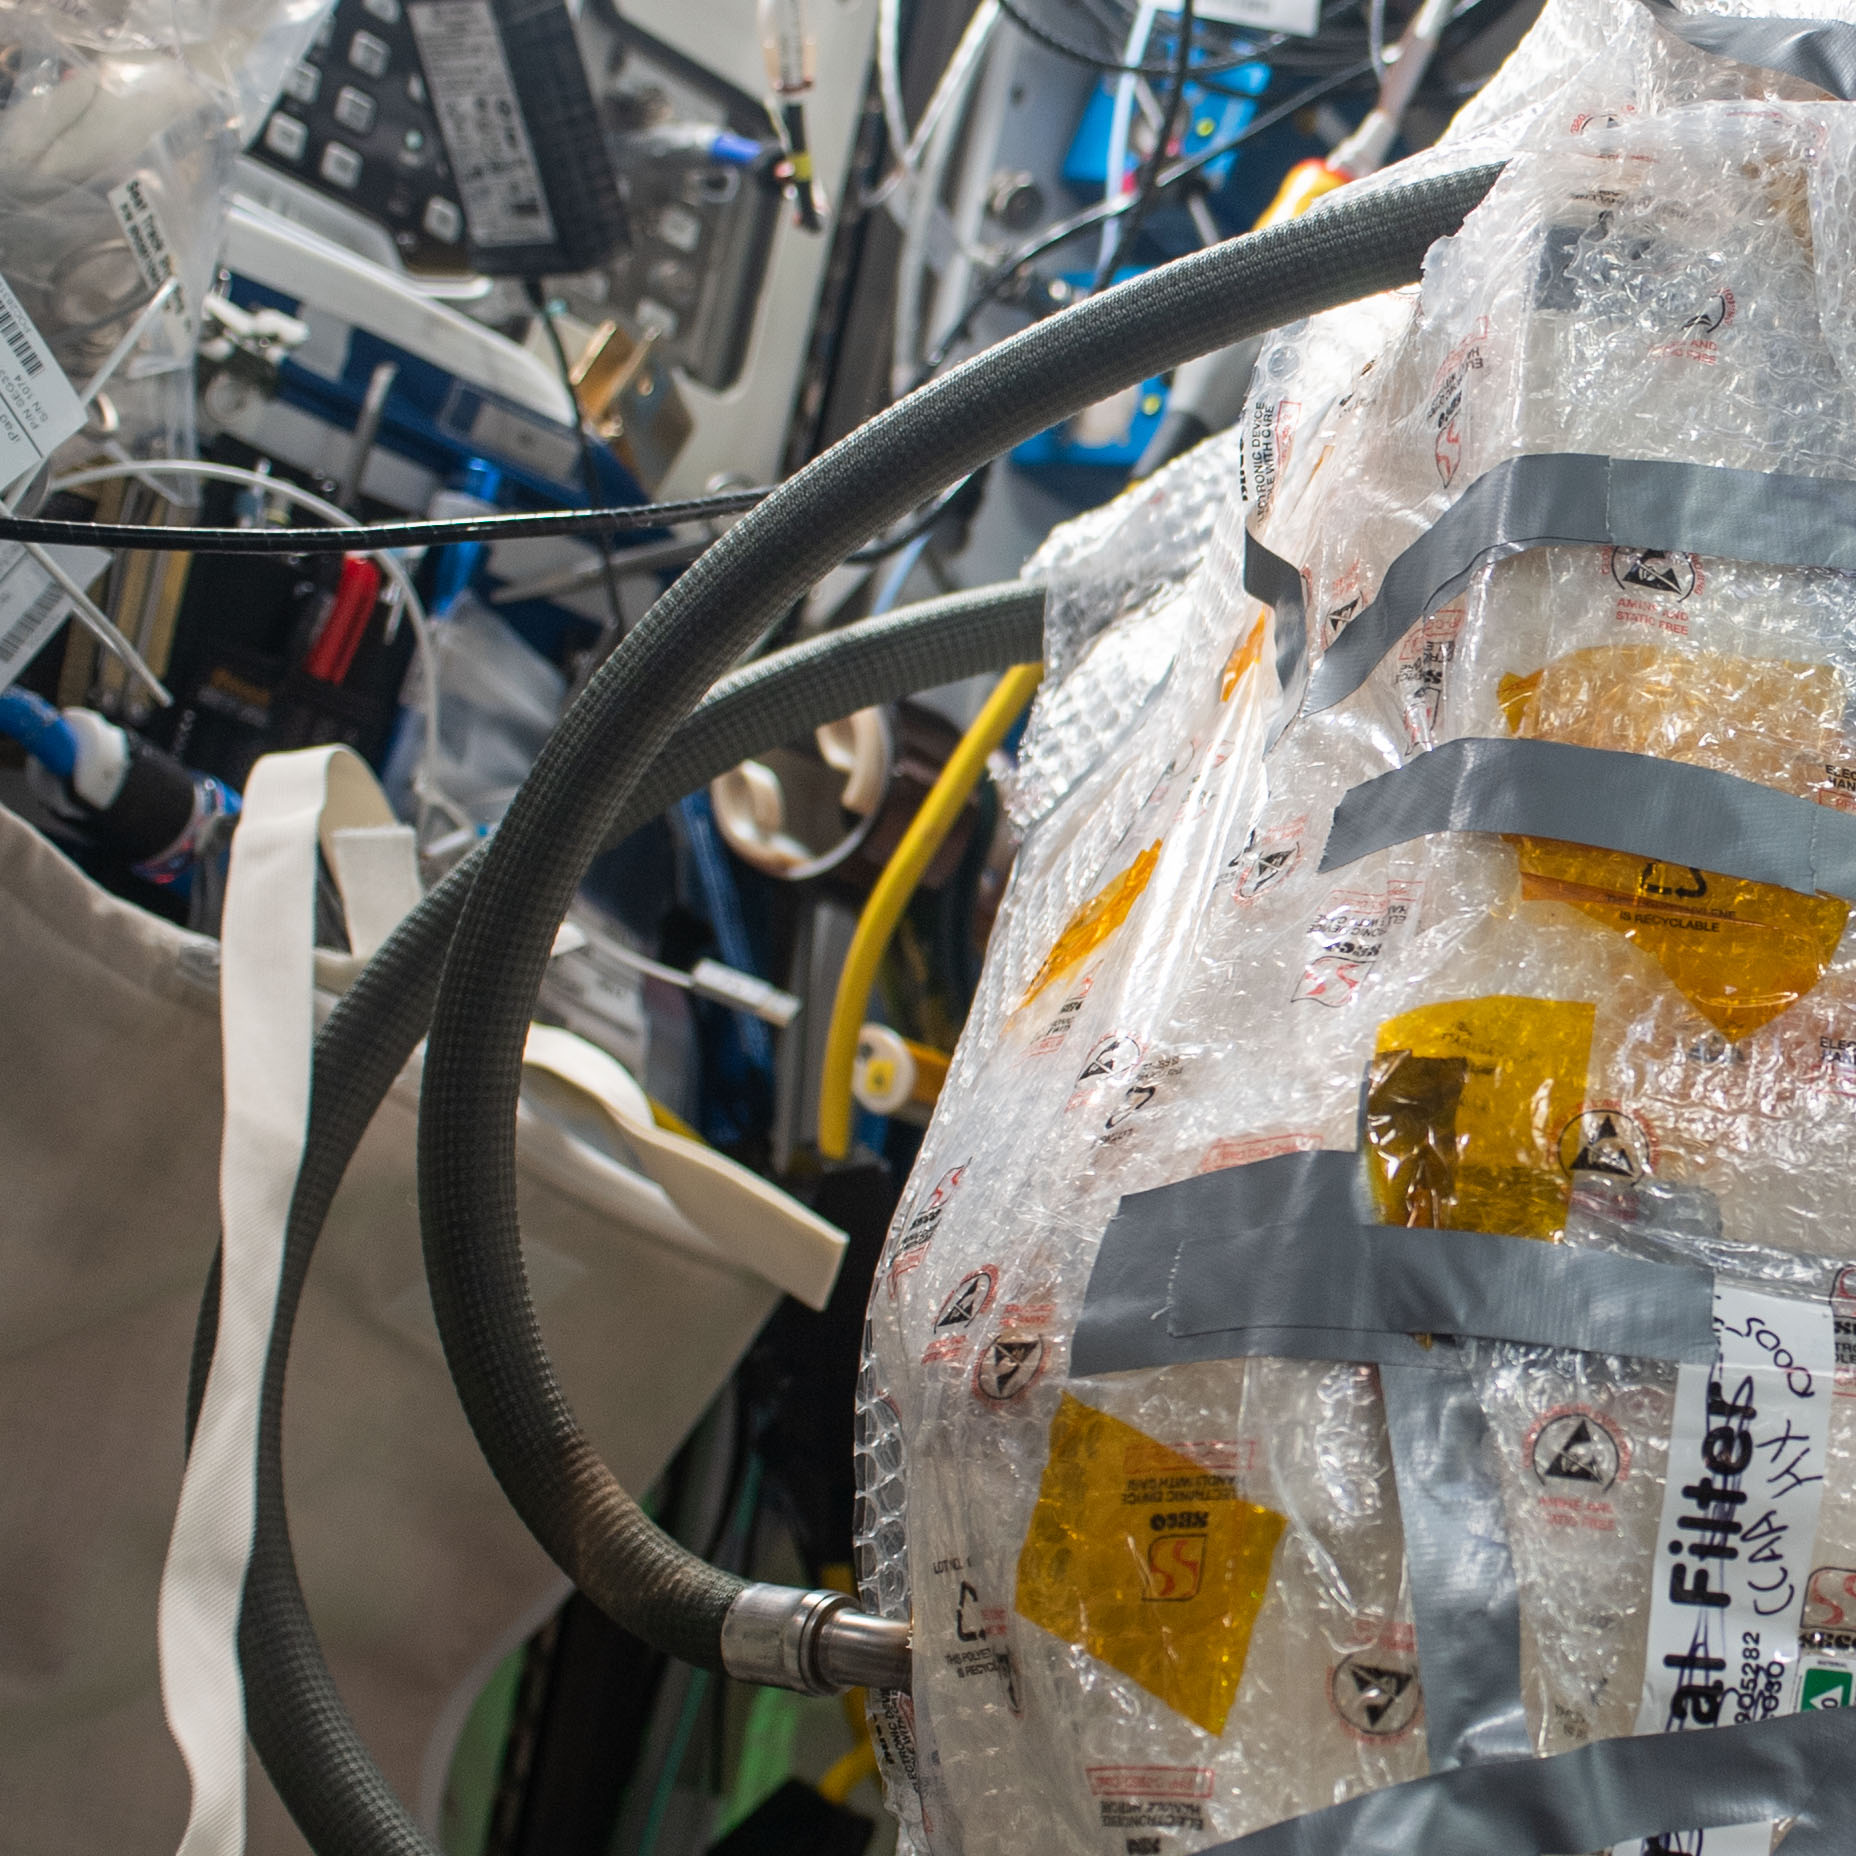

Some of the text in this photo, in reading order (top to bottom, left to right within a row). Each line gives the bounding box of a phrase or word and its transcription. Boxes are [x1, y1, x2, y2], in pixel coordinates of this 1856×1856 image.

[1615, 610, 1689, 636] STATIC FREE
[1619, 911, 1721, 932] IS RECYCLABLE
[1671, 1380, 1757, 1607] Filter
